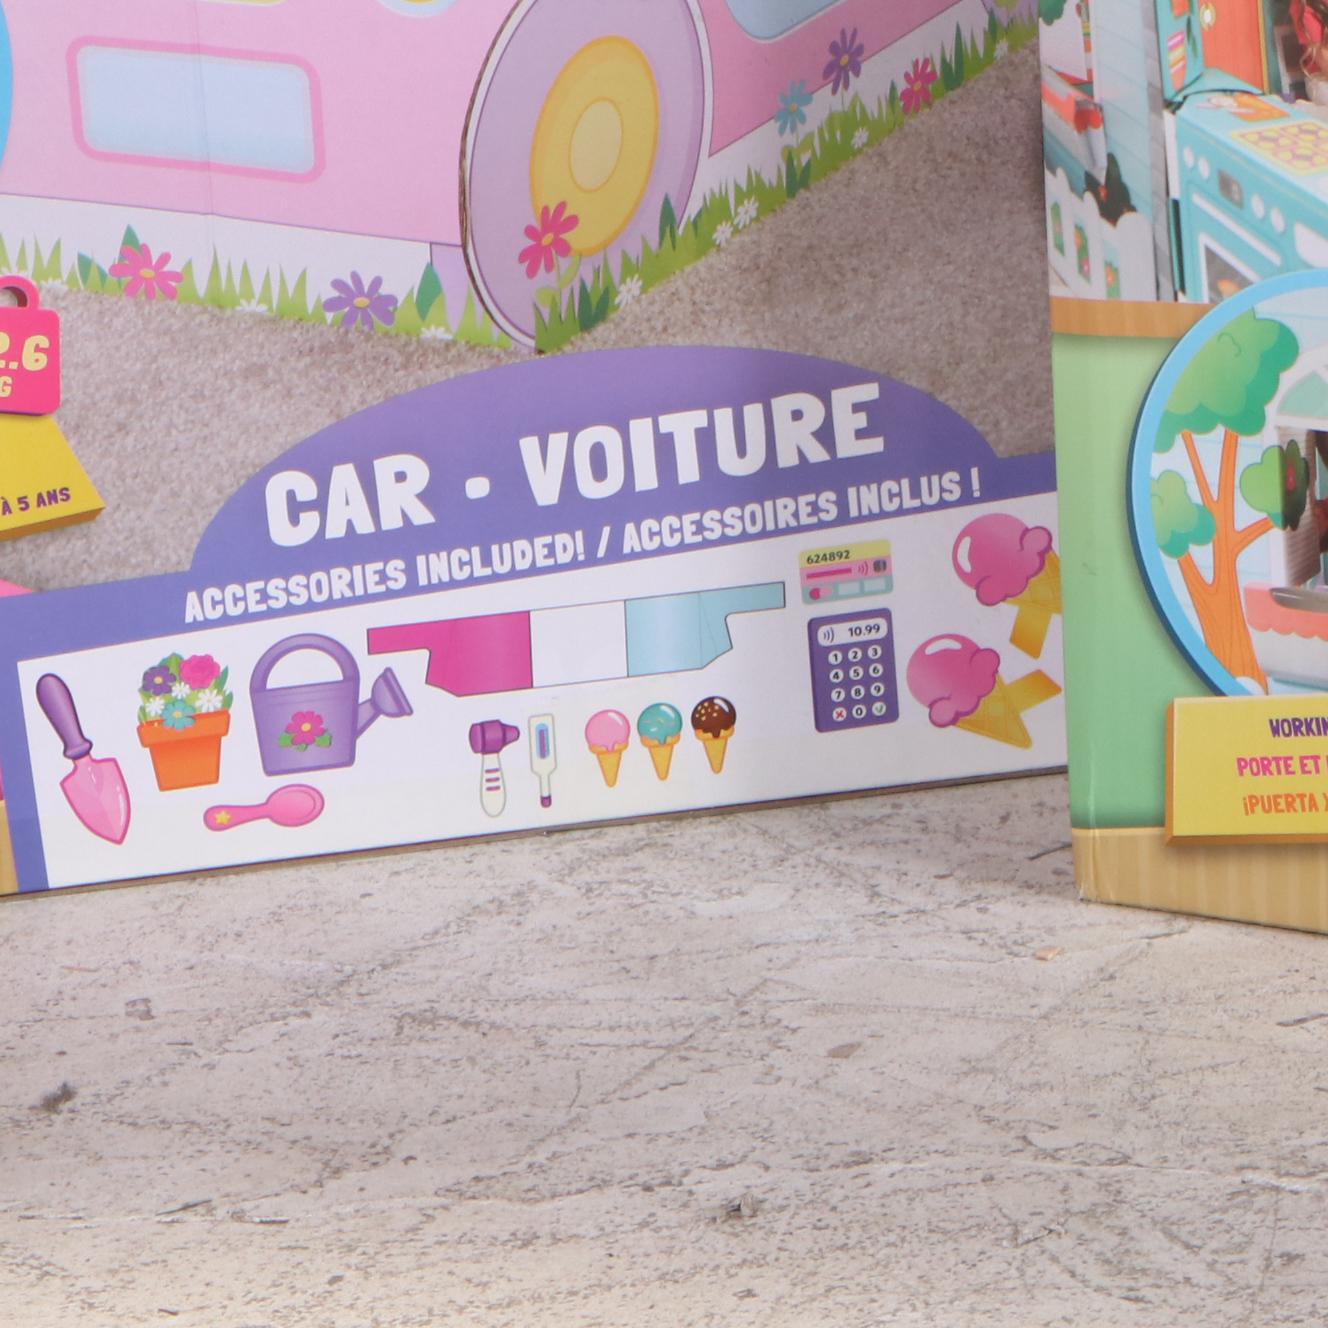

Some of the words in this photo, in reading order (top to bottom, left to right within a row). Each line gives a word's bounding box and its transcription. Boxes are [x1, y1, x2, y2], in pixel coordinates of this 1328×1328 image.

[264, 452, 436, 547] CAR
[519, 382, 884, 506] VOITURE
[18, 496, 30, 511] 5
[36, 487, 71, 508] ANS
[184, 558, 407, 623] ACCESSORIES
[417, 529, 585, 587] INCLUDED!
[623, 490, 838, 555] ACCESSOIRES
[806, 550, 850, 565] 624892
[848, 624, 881, 637] 10.99
[1237, 756, 1295, 777] PORTE
[1300, 755, 1321, 775] ET
[1243, 793, 1319, 816] ¡PUERTA
